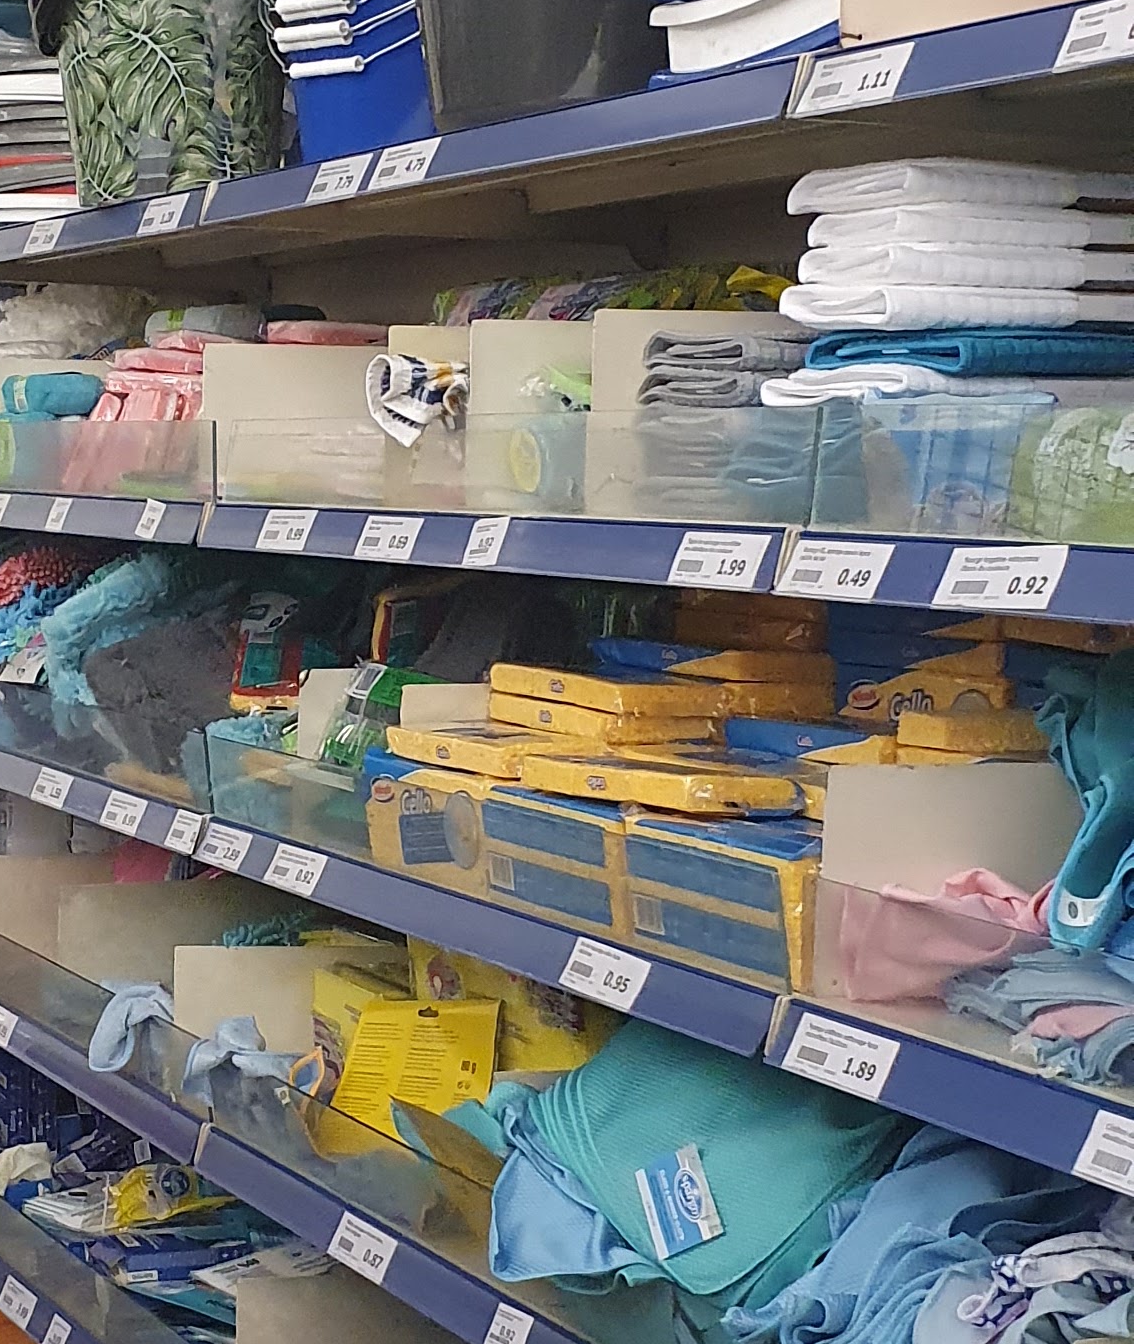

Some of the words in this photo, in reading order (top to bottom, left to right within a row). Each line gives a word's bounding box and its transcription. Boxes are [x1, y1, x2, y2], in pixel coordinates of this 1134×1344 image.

[857, 69, 890, 92] 1.11
[716, 558, 746, 576] 1.99
[837, 568, 870, 587] 0.49
[1007, 576, 1048, 595] 0.92
[402, 788, 432, 814] Cello
[603, 970, 630, 992] 0.95
[842, 1057, 876, 1081] 1.89
[499, 1325, 516, 1341] 0.92
